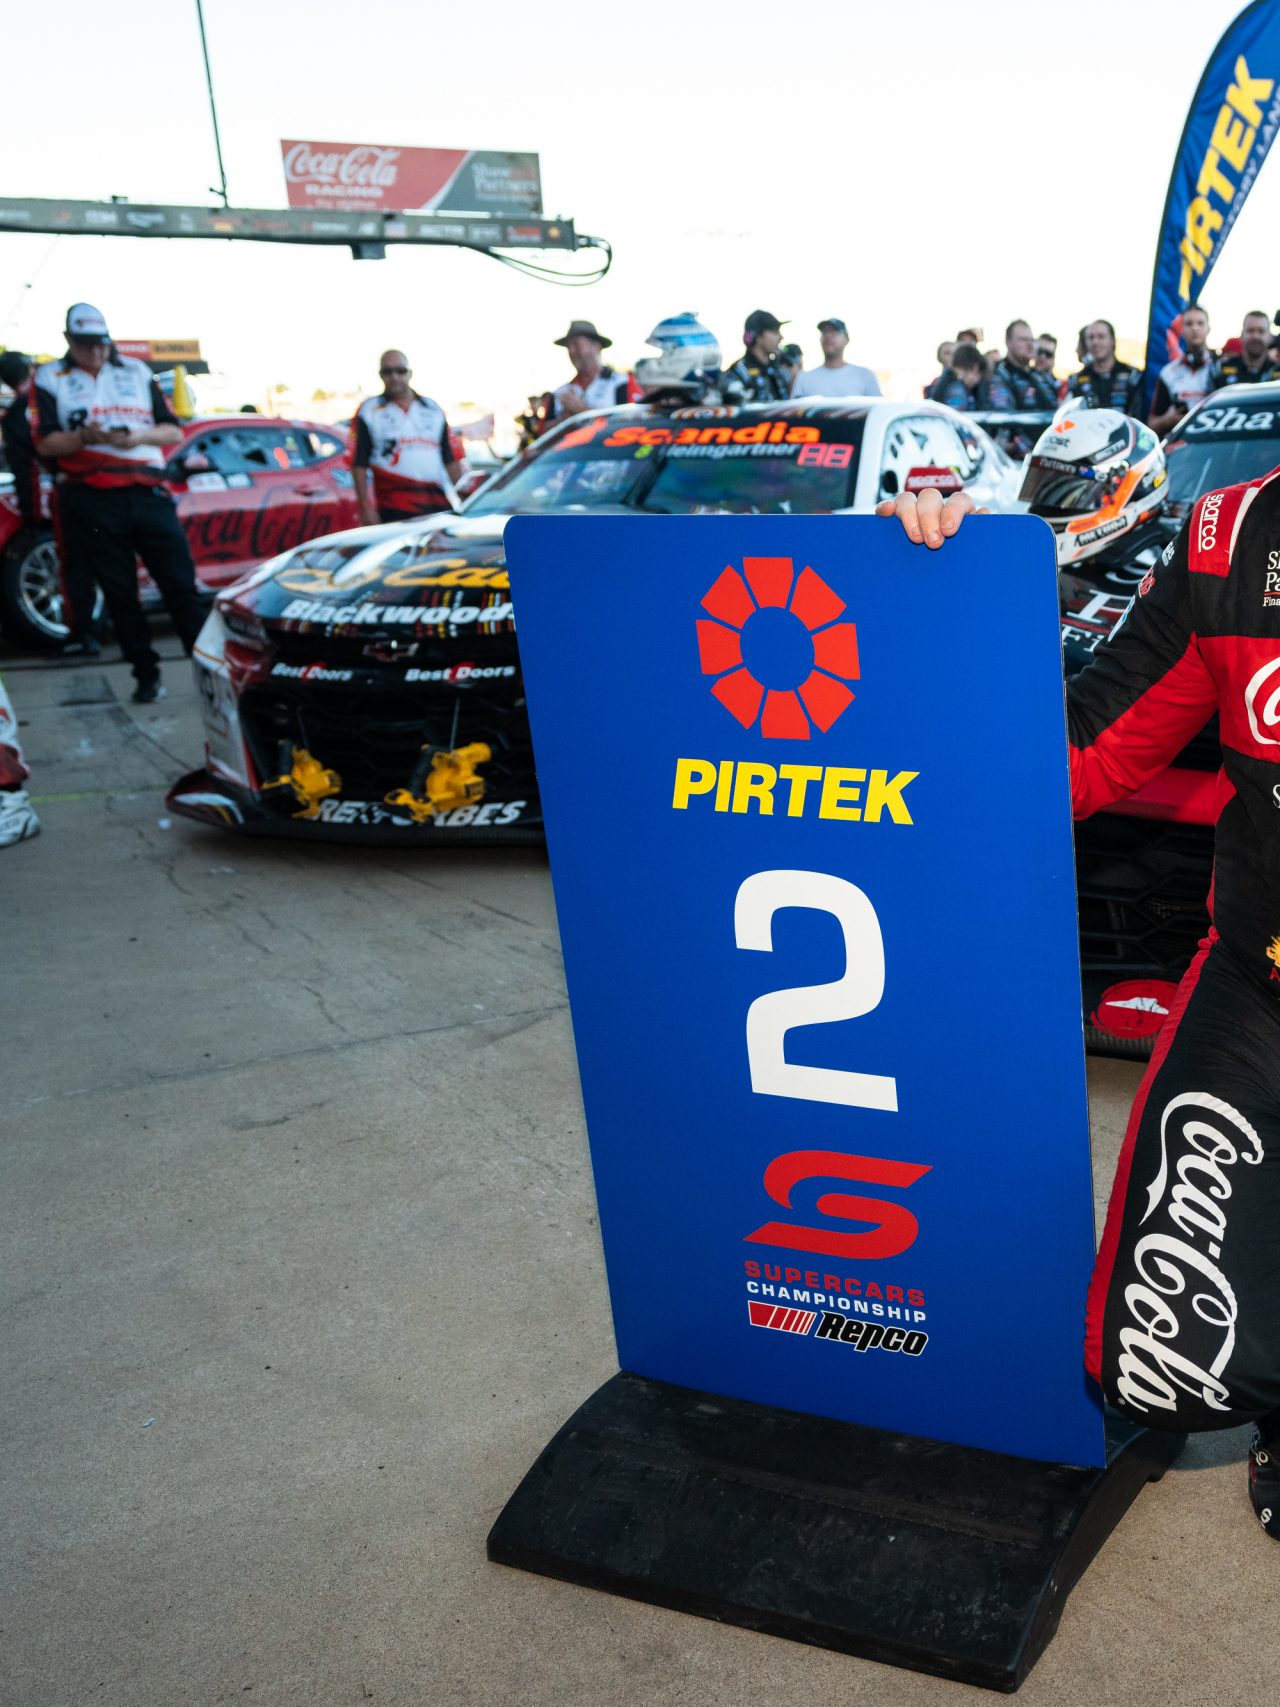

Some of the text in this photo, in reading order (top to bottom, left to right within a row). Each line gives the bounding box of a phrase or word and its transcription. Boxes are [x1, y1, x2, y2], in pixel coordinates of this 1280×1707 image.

[284, 143, 401, 186] Coca-Cola
[306, 184, 384, 198] RACING
[603, 421, 820, 446] Scandia
[1200, 493, 1225, 551] sparco
[672, 758, 920, 825] PIRTEK
[734, 869, 899, 1113] 2
[1117, 1091, 1264, 1412] Coca-Cola
[743, 1260, 926, 1308] SUPERCARS
[746, 1281, 927, 1324] CHAMPIONSHIP
[814, 1309, 930, 1357] Repco
